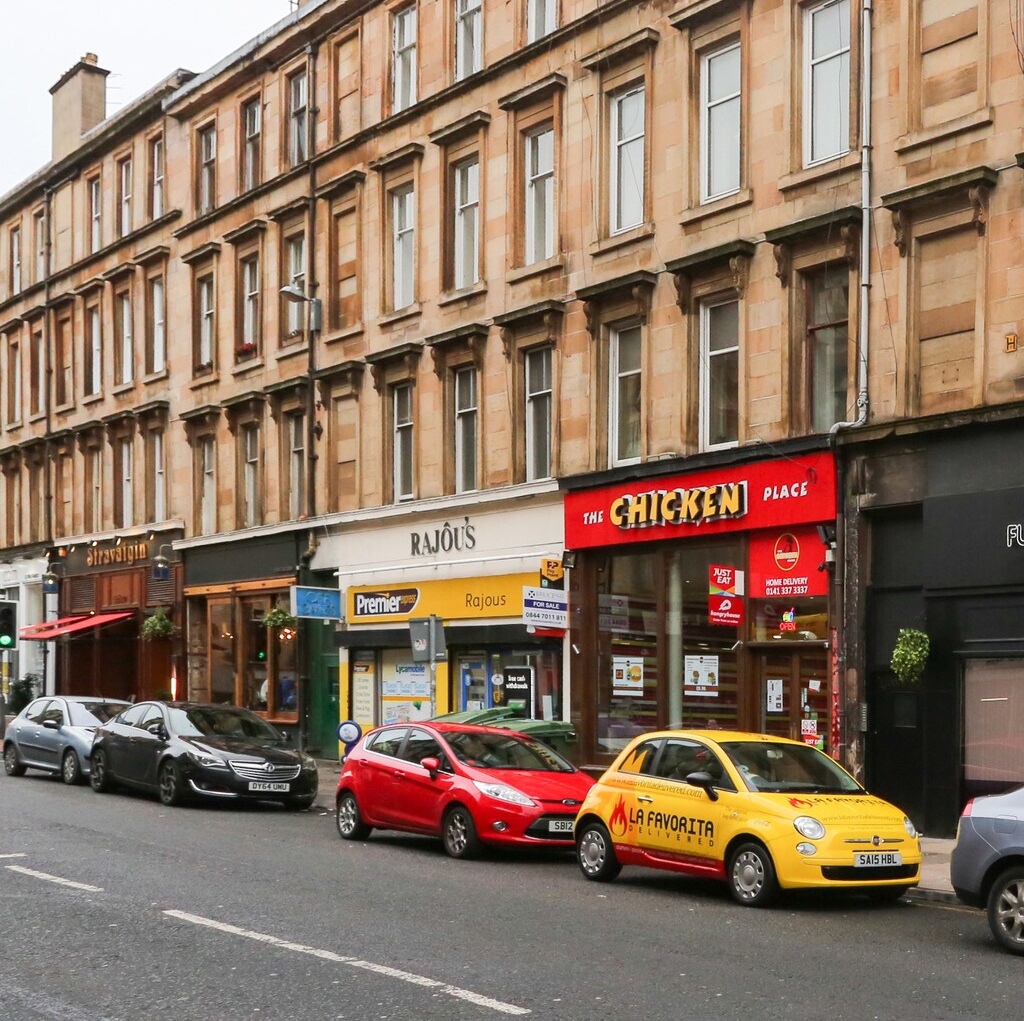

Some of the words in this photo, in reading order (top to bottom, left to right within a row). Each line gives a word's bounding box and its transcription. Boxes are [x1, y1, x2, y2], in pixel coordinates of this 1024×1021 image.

[583, 511, 604, 525] THE
[609, 480, 748, 529] CHICKEN
[763, 481, 808, 501] PLACE
[713, 568, 732, 577] JUST
[717, 577, 732, 585] EAT
[766, 579, 783, 587] HOME
[783, 577, 808, 586] DELIVERY
[766, 588, 780, 596] 0141
[781, 587, 792, 595] 337
[793, 586, 808, 594] 3337
[356, 594, 401, 615] Premier
[465, 593, 506, 610] Rajous
[542, 613, 555, 621] 7011
[780, 623, 796, 631] OPEN
[396, 663, 426, 674] Lycamobile
[554, 821, 574, 830] SB12
[629, 808, 644, 825] LA
[647, 811, 714, 838] FAVORITA
[629, 825, 714, 847] DELIVERED
[860, 854, 880, 865] SA15
[881, 853, 898, 864] HBL
